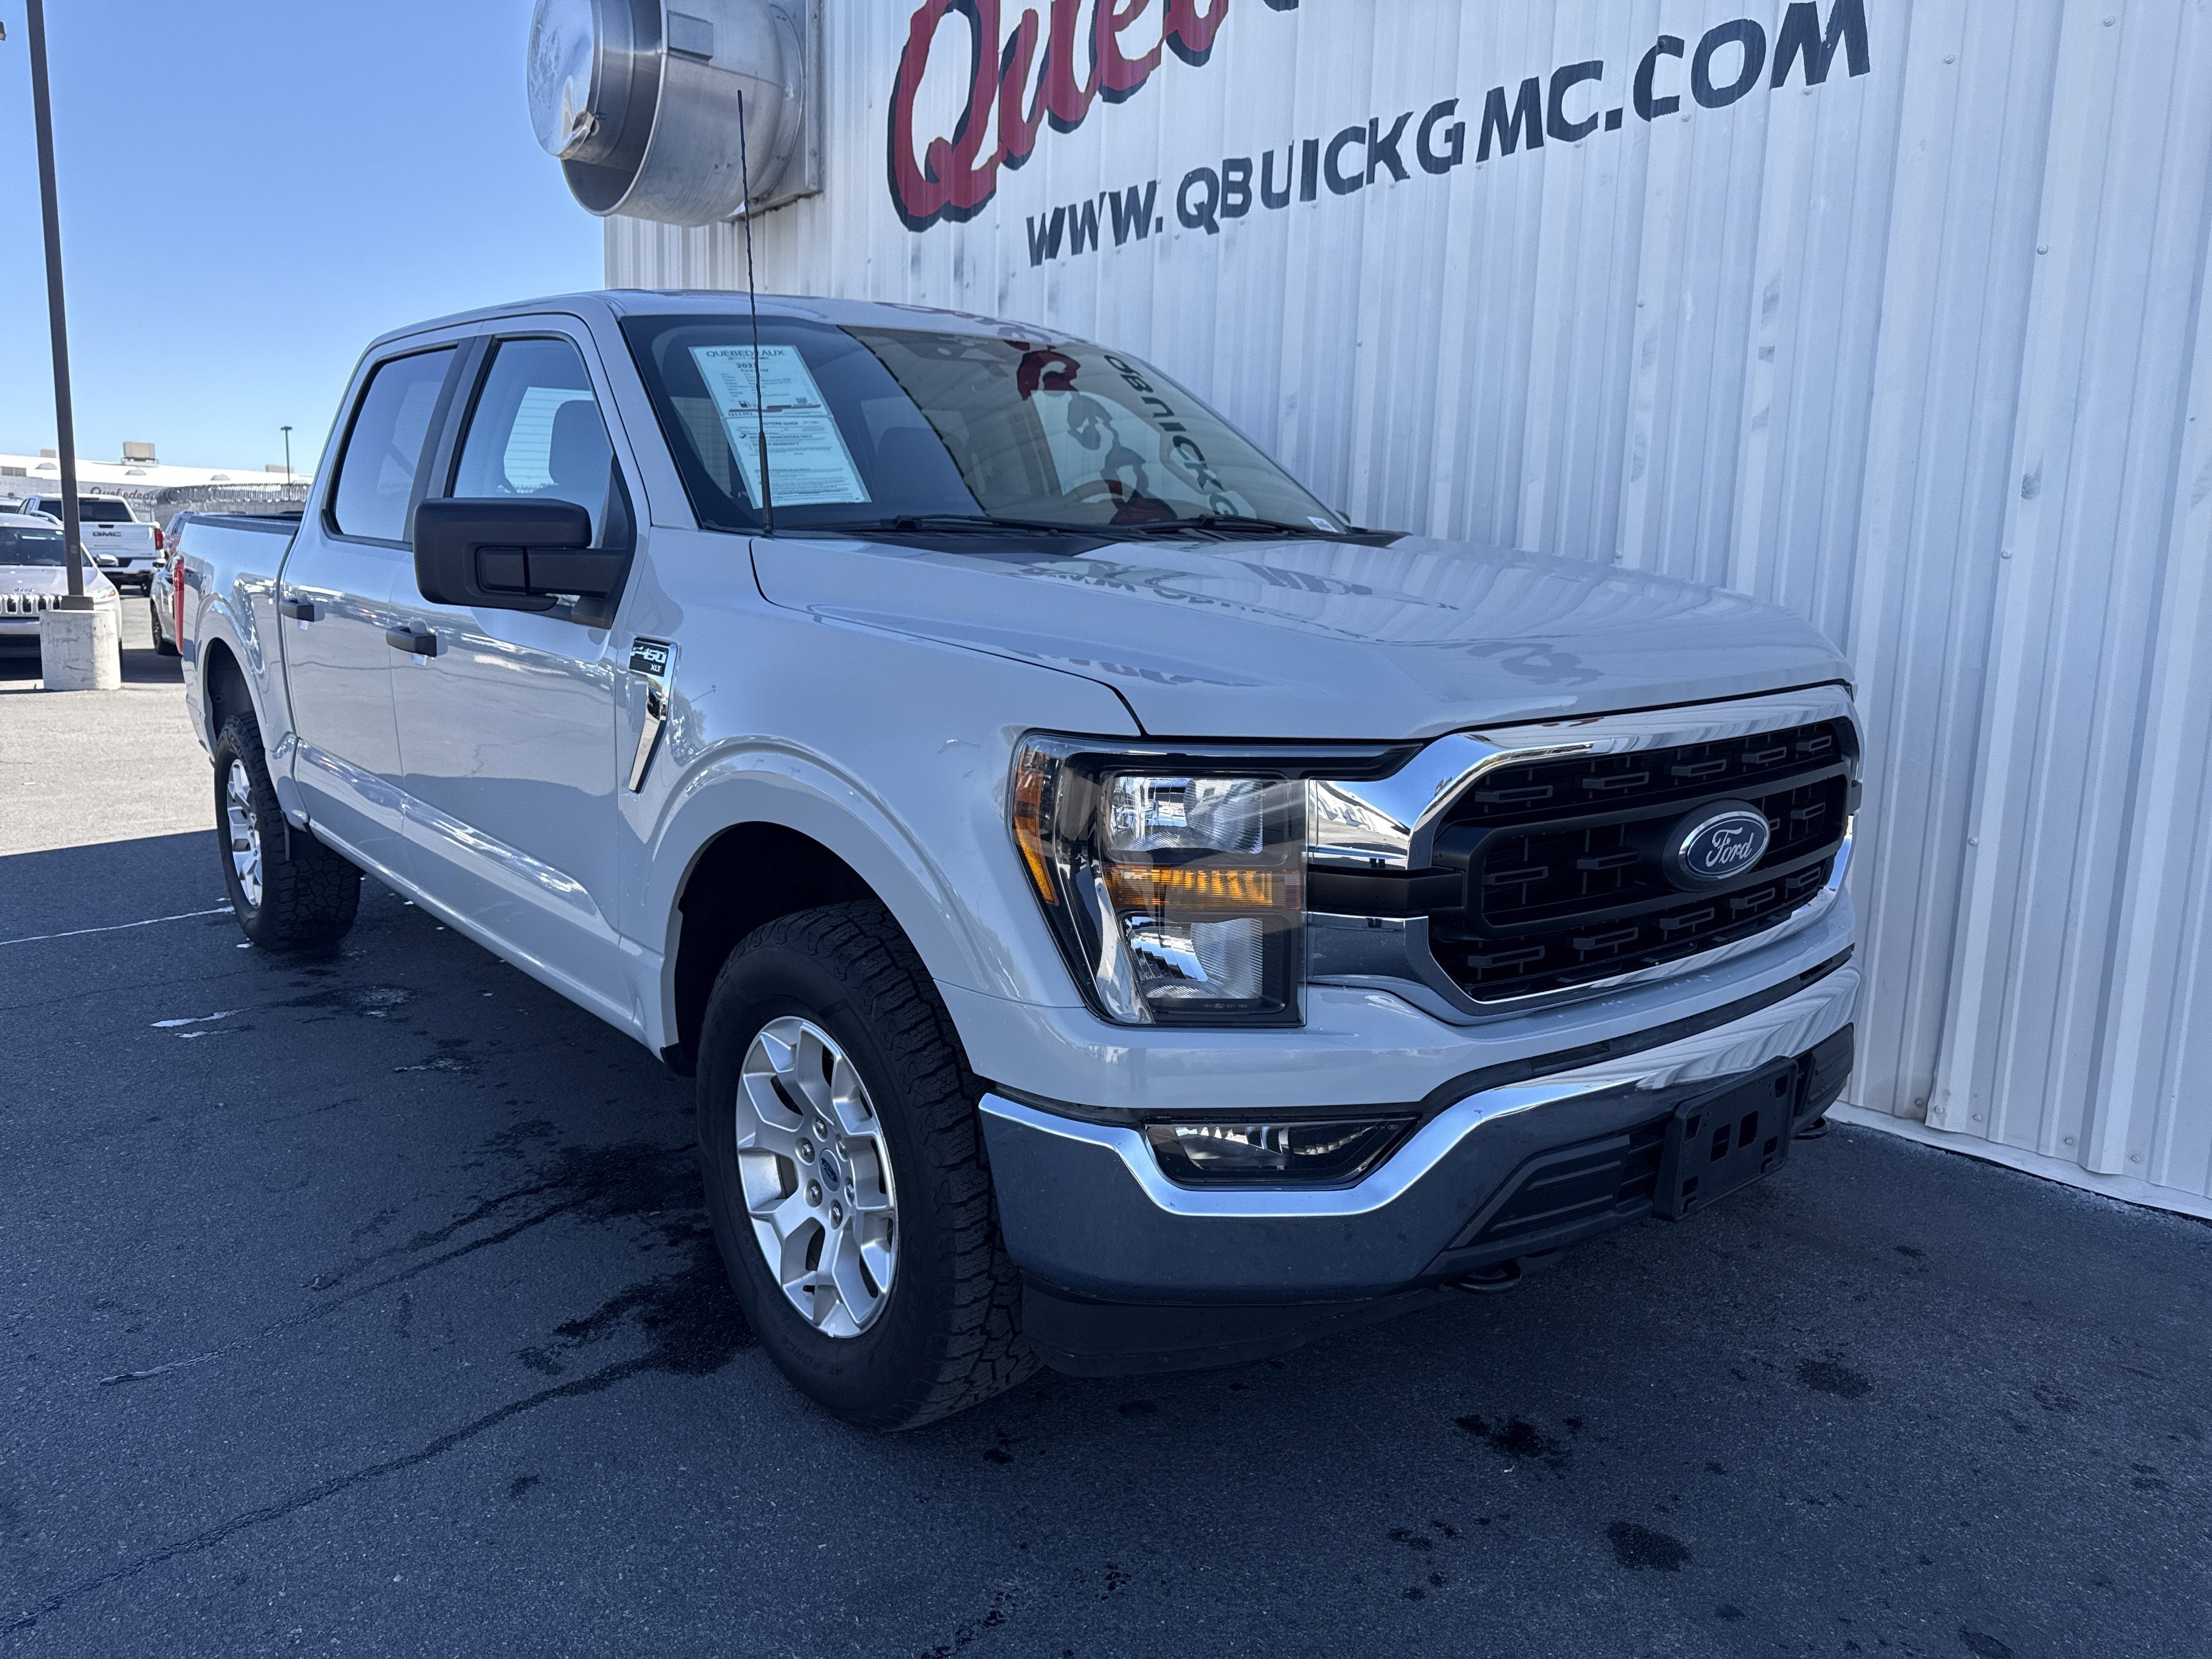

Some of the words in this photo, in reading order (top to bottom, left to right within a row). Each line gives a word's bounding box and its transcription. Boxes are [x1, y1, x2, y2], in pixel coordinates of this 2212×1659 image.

[1026, 0, 1870, 267] WWW.QBUICKGMC.COM
[651, 664, 662, 672] XLT
[1706, 827, 1754, 867] Ford
